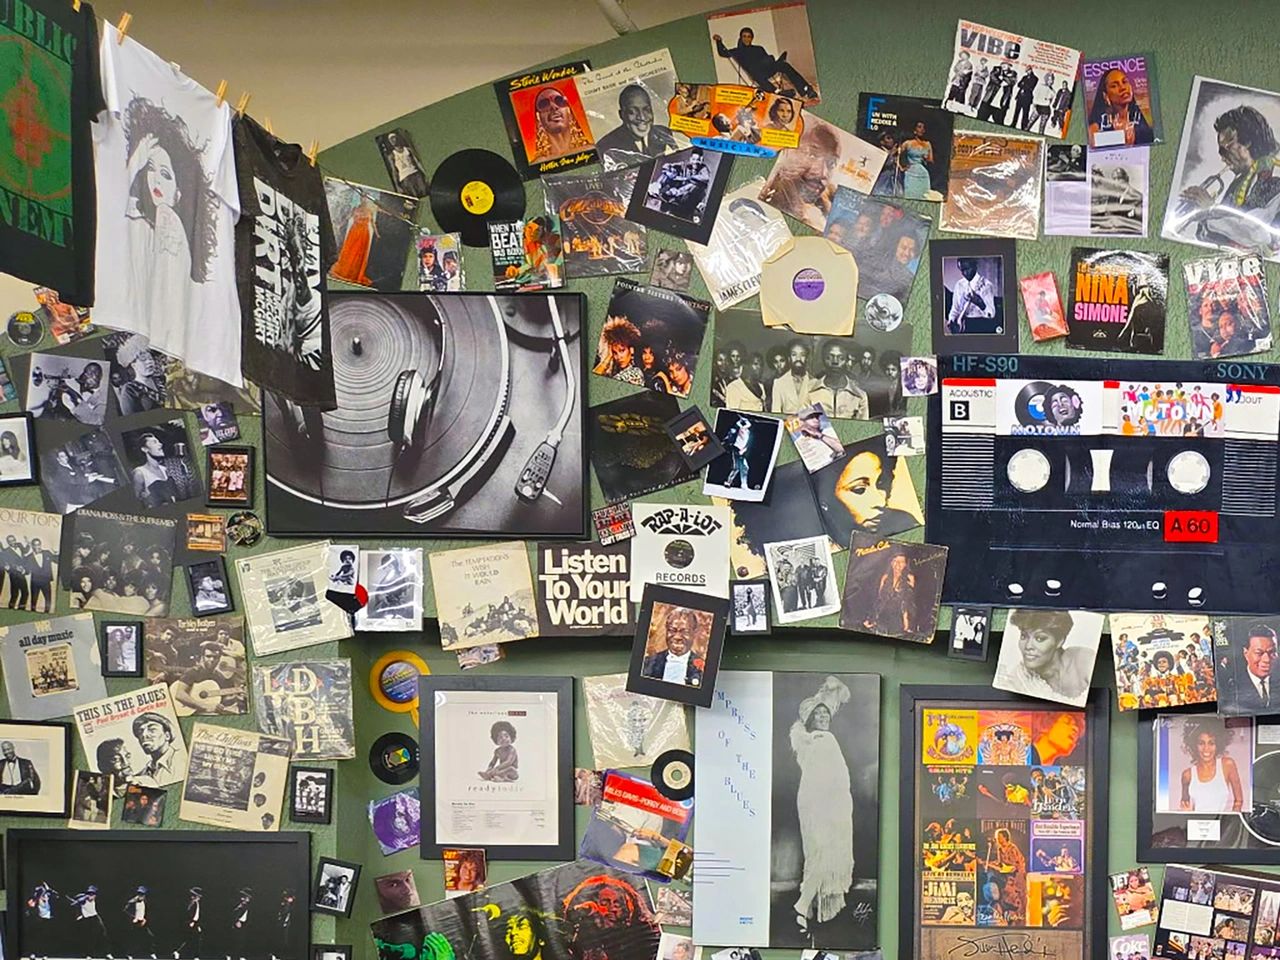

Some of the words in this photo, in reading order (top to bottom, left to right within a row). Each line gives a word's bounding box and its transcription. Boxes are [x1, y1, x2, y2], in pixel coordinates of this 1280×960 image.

[1074, 273, 1129, 304] NINA
[1074, 302, 1129, 323] SIMONE
[953, 356, 1019, 374] HF-S90
[1217, 362, 1268, 381] SONY
[30, 512, 60, 528] TOPS
[641, 508, 722, 536] RAP-A-LOT
[1070, 519, 1099, 531] Normal
[1101, 519, 1121, 531] Bias
[1170, 518, 1183, 534] A
[1187, 518, 1211, 535] 60
[545, 550, 627, 574] Listen
[539, 574, 571, 598] To
[576, 574, 631, 598] Your
[656, 572, 706, 584] RECORDS
[550, 600, 628, 625] World
[19, 636, 32, 647] all
[33, 633, 47, 646] day
[76, 706, 100, 722] THIS
[101, 703, 112, 716] IS
[115, 697, 135, 713] THE
[136, 687, 167, 708] BLUES
[1111, 875, 1129, 889] JET
